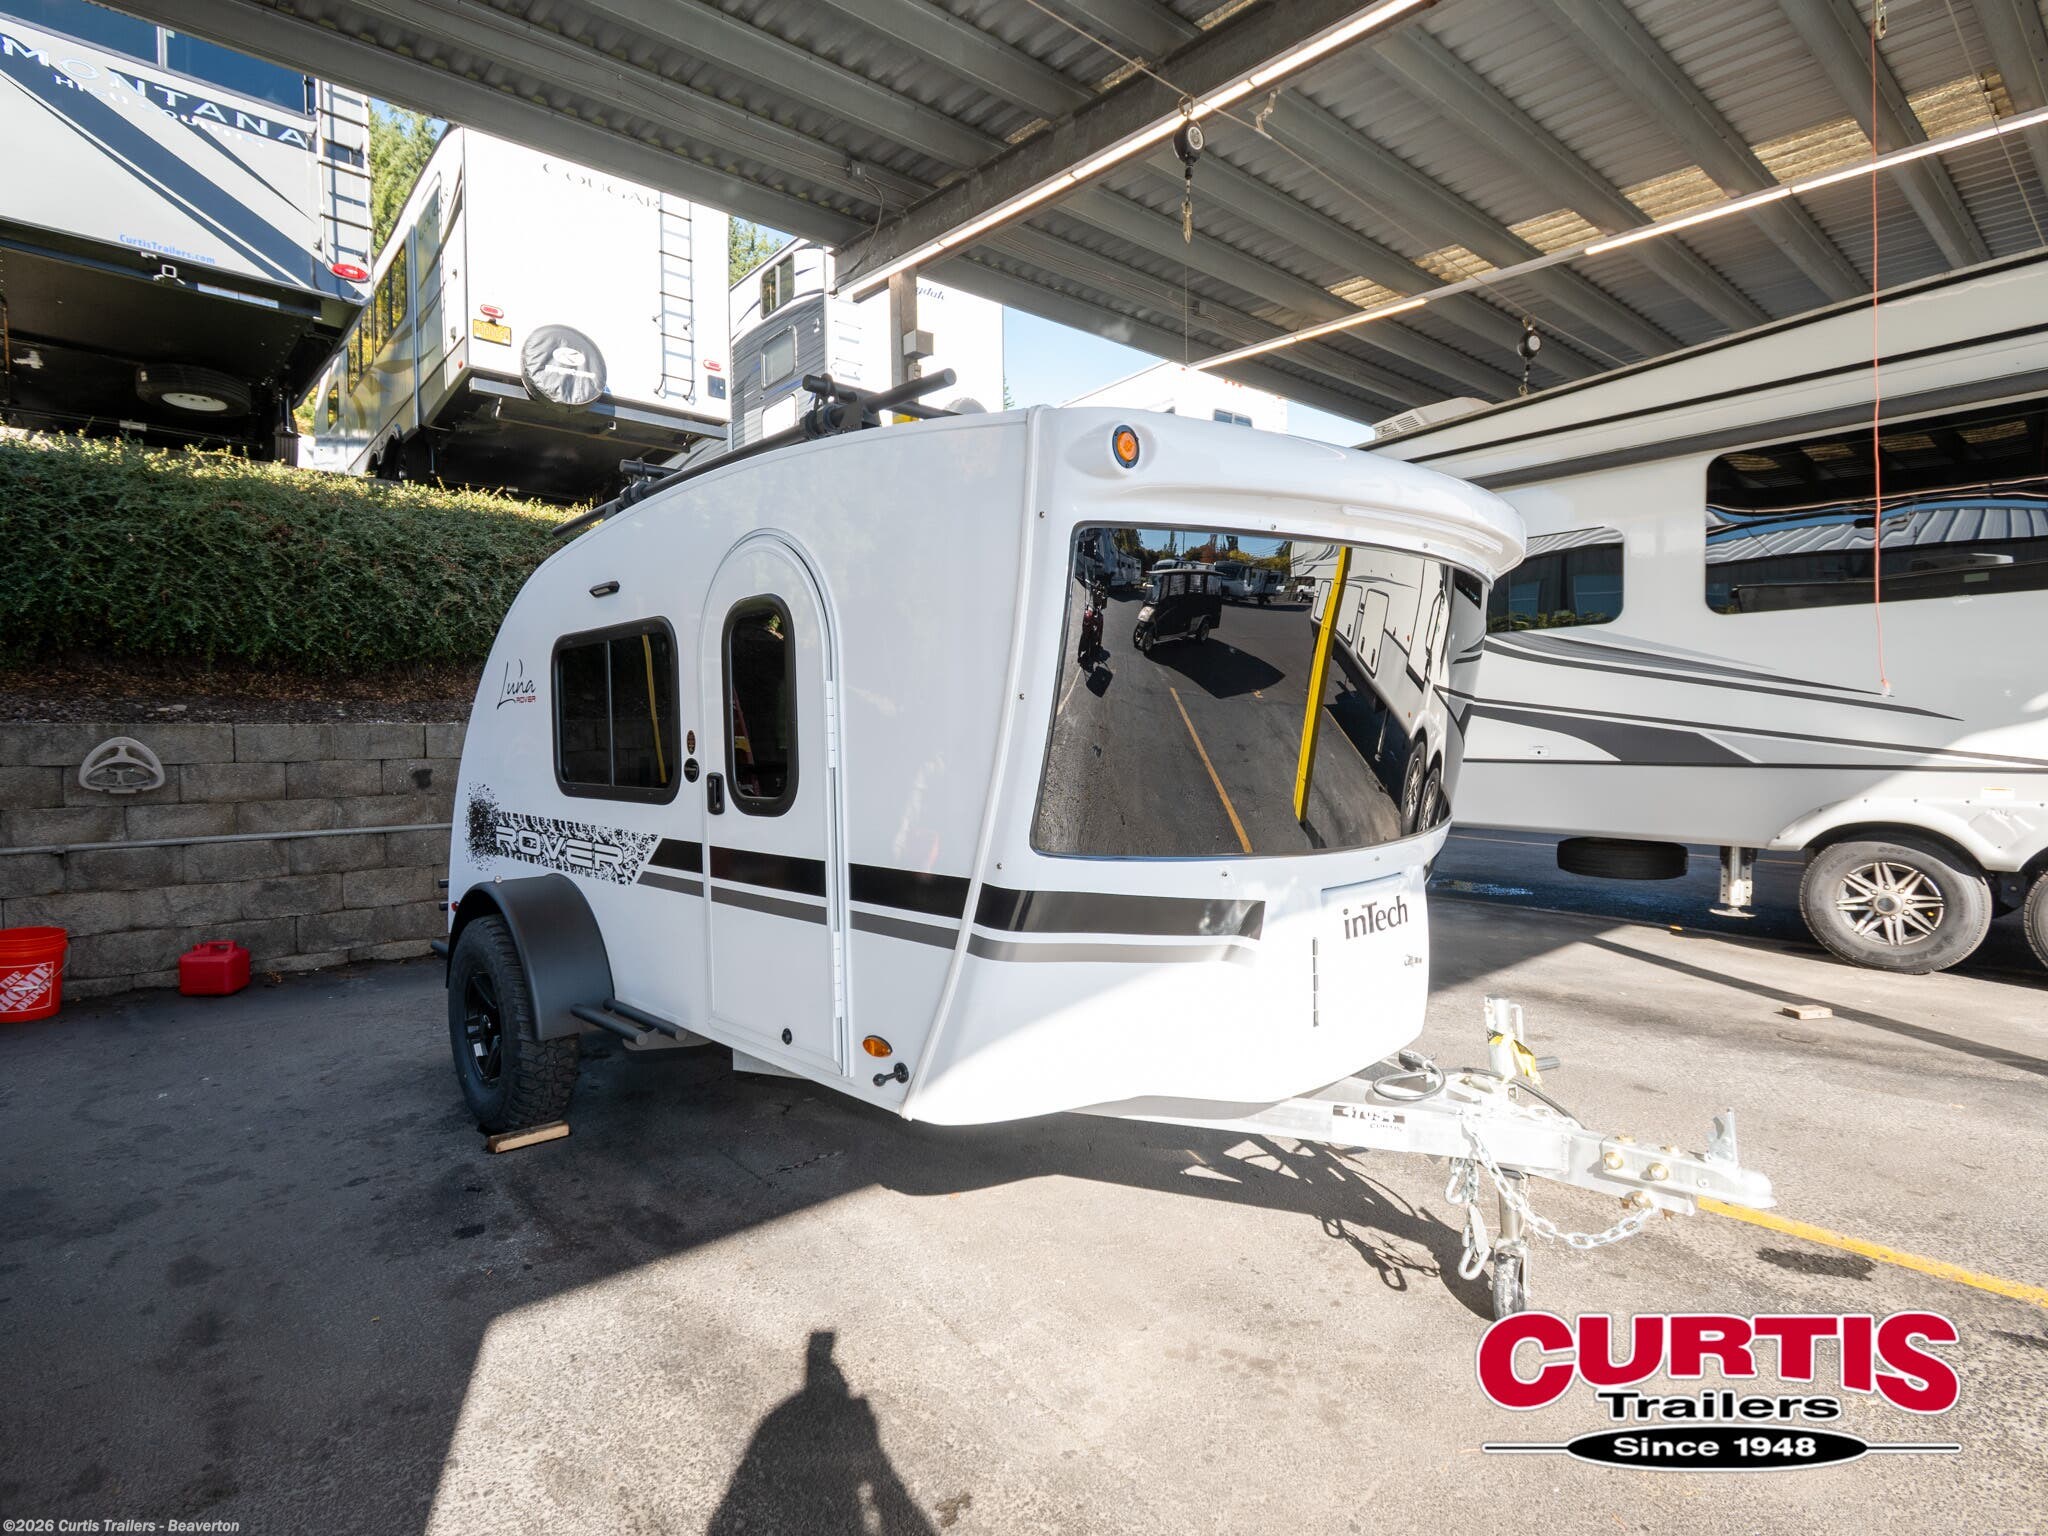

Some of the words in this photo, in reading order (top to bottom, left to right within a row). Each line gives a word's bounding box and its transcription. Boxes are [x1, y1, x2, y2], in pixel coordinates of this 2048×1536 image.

[2, 36, 310, 149] MONTANA
[496, 658, 537, 710] Luna
[495, 825, 627, 876] ROVER
[1343, 895, 1409, 940] inTech
[0, 970, 25, 990] THE
